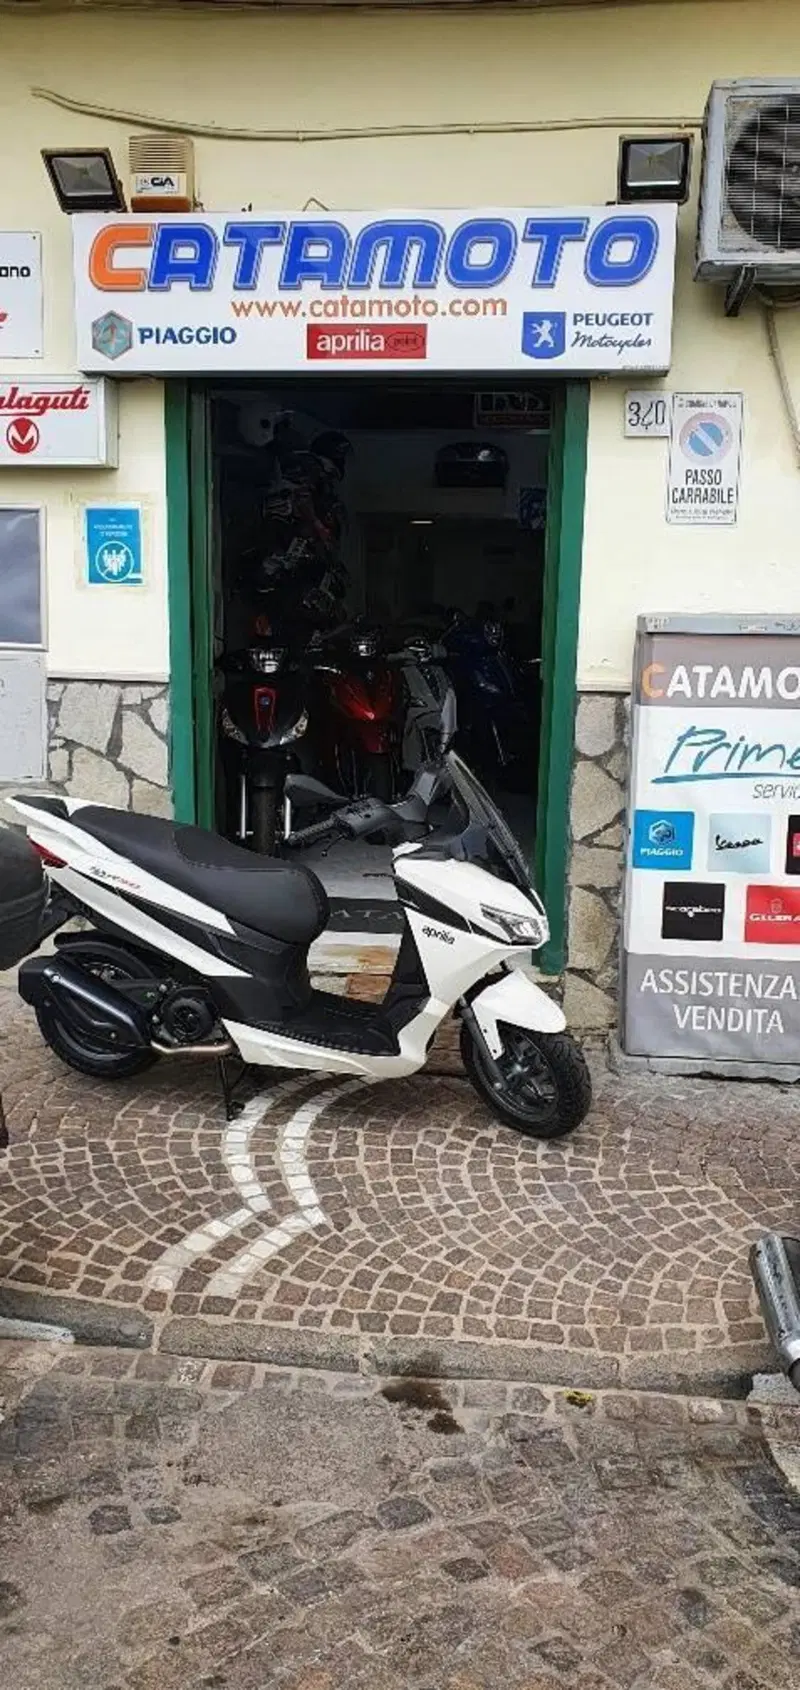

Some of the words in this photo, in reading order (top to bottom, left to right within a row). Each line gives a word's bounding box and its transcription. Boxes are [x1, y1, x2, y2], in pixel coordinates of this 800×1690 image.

[88, 216, 660, 292] CATAMOTO
[231, 295, 508, 318] www.catamoto.com
[572, 312, 654, 326] PEUGEOT
[137, 326, 238, 345] PIAGGIO
[316, 328, 385, 355] aprilia
[570, 331, 653, 356] Motocycles
[685, 469, 722, 486] PASSO
[671, 487, 734, 505] CARRABILE
[641, 663, 800, 701] CATAMO
[640, 847, 684, 857] PIAGGIO
[421, 925, 456, 945] aprilia
[640, 969, 798, 1001] ASSISTENZA
[672, 1004, 785, 1034] VENDITA
